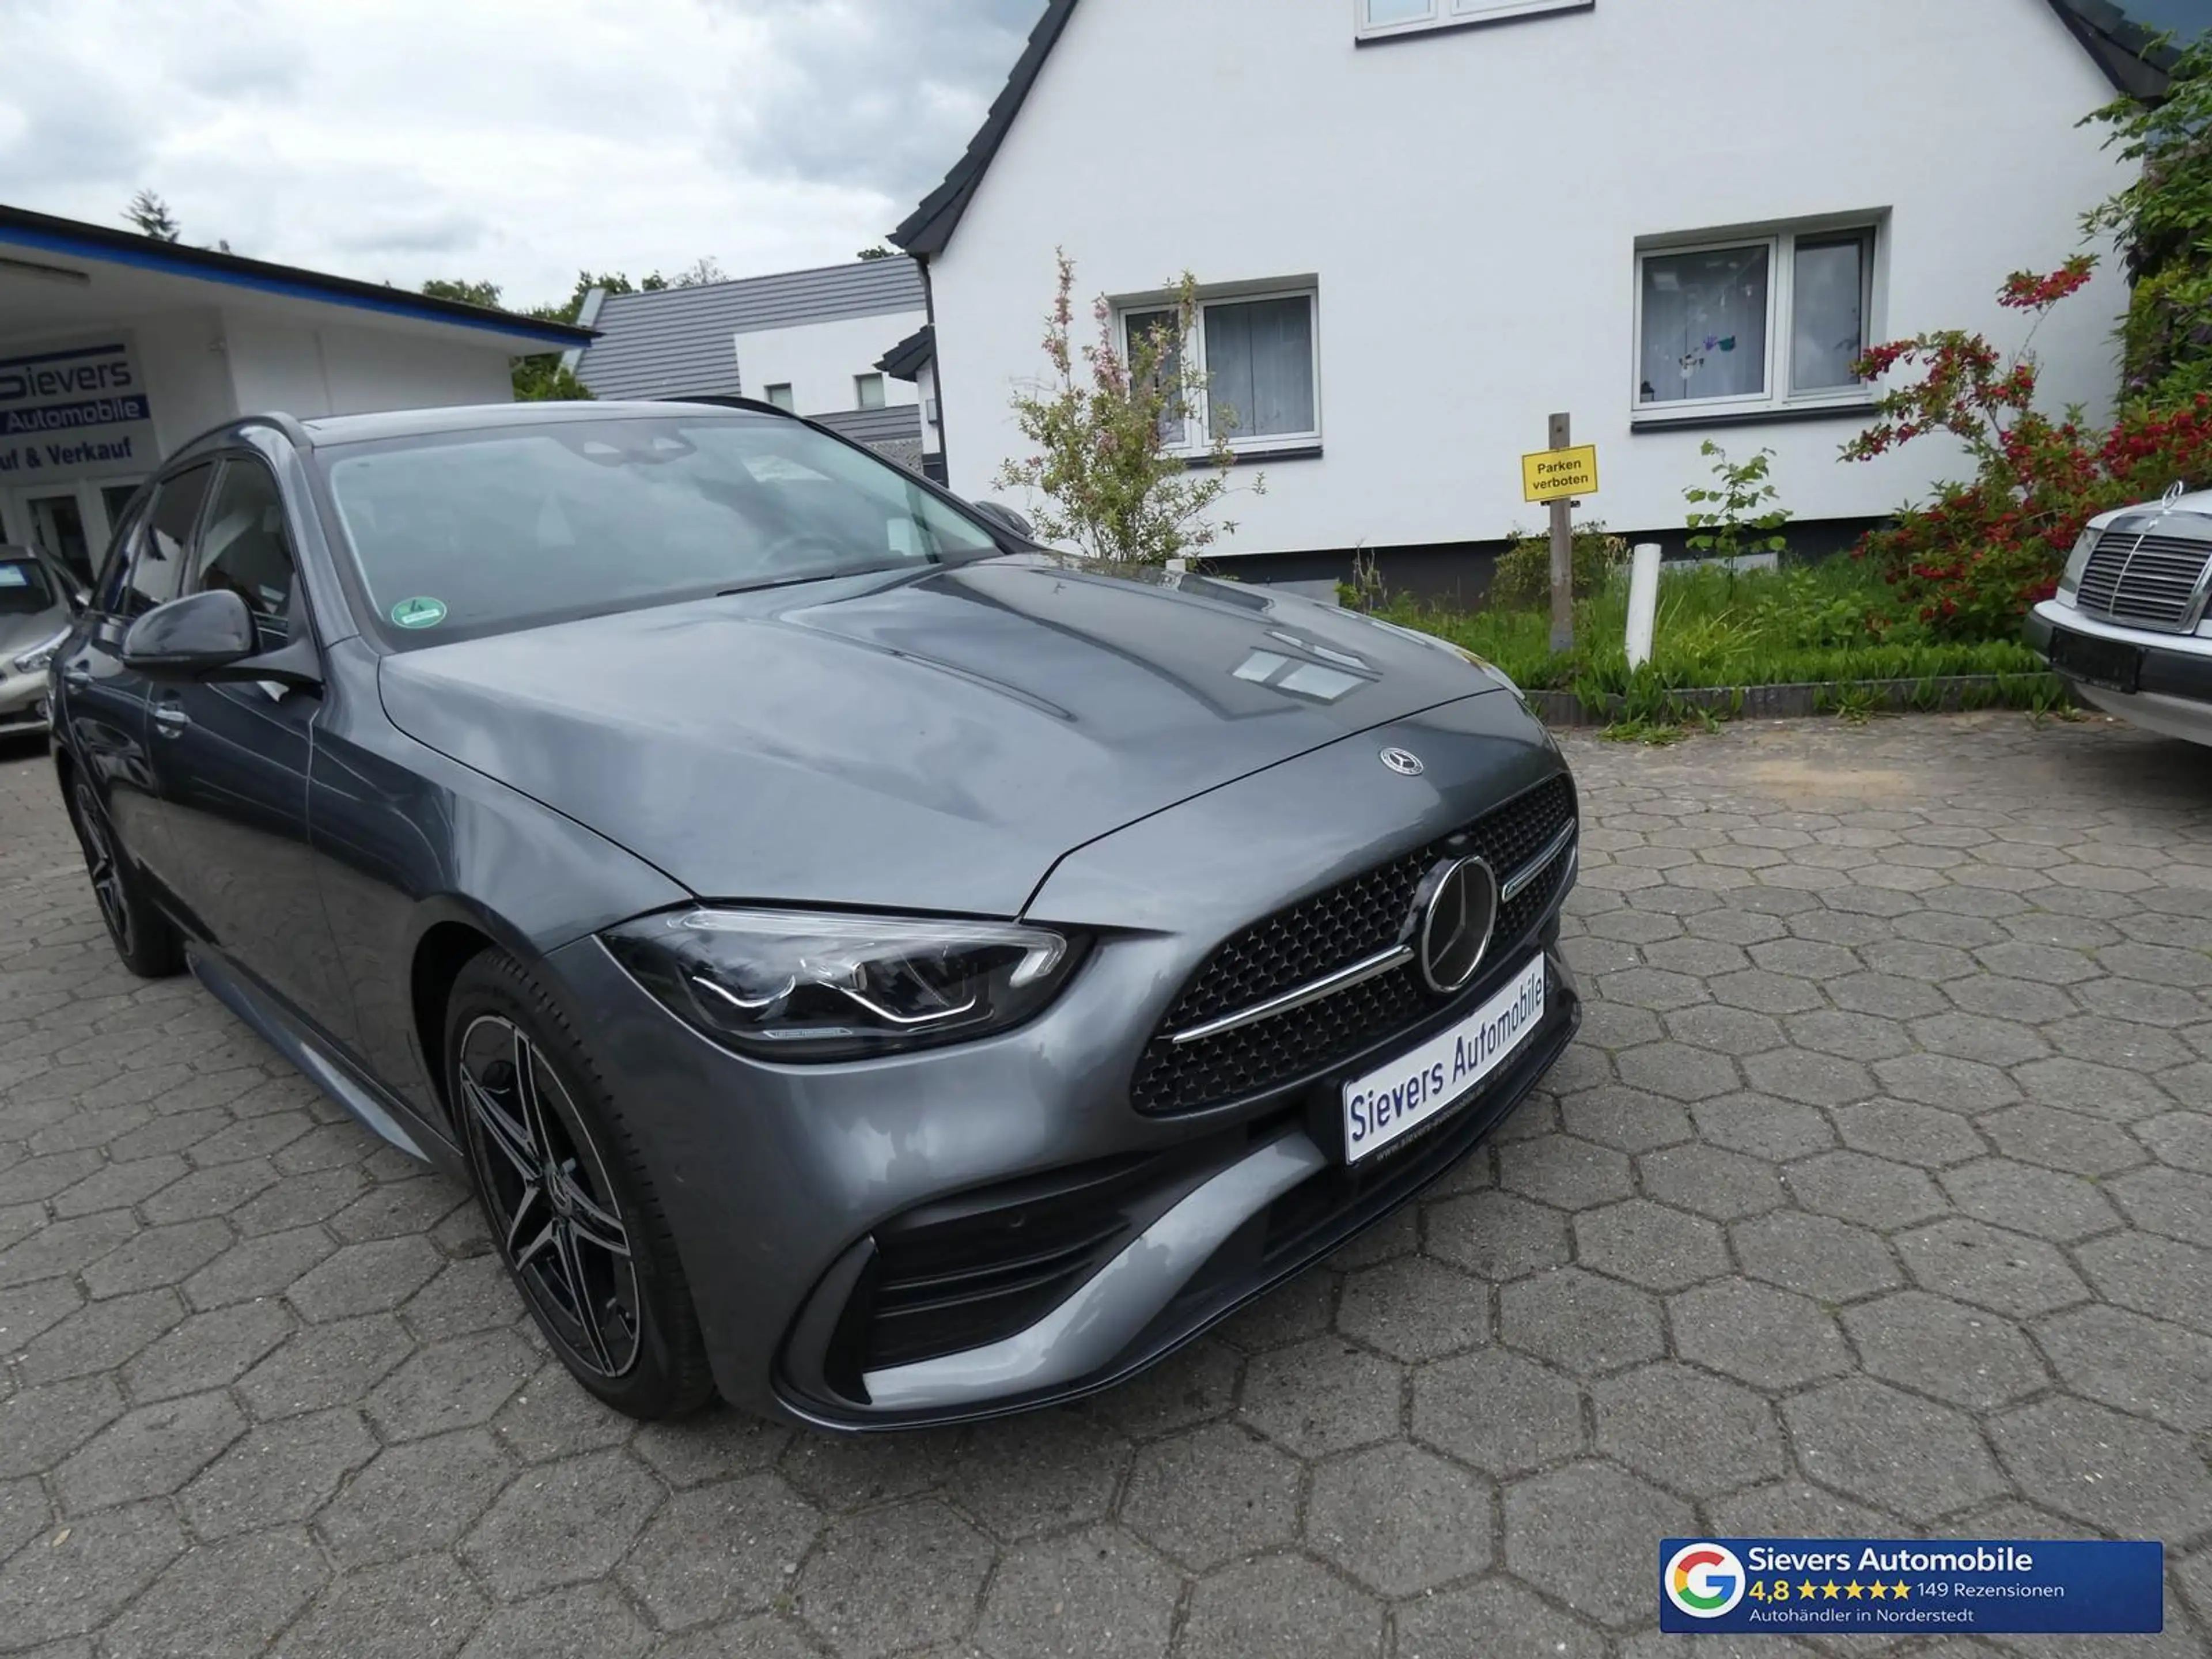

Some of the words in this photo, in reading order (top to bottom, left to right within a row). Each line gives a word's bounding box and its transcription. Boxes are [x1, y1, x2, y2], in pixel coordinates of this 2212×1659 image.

[6, 399, 140, 432] Automobile
[25, 446, 43, 468] &
[46, 435, 132, 465] Verkauf
[1537, 460, 1582, 474] Parken
[1532, 475, 1589, 490] verboten
[1350, 1063, 1444, 1142] Sievers
[1452, 972, 1542, 1085] Automobile
